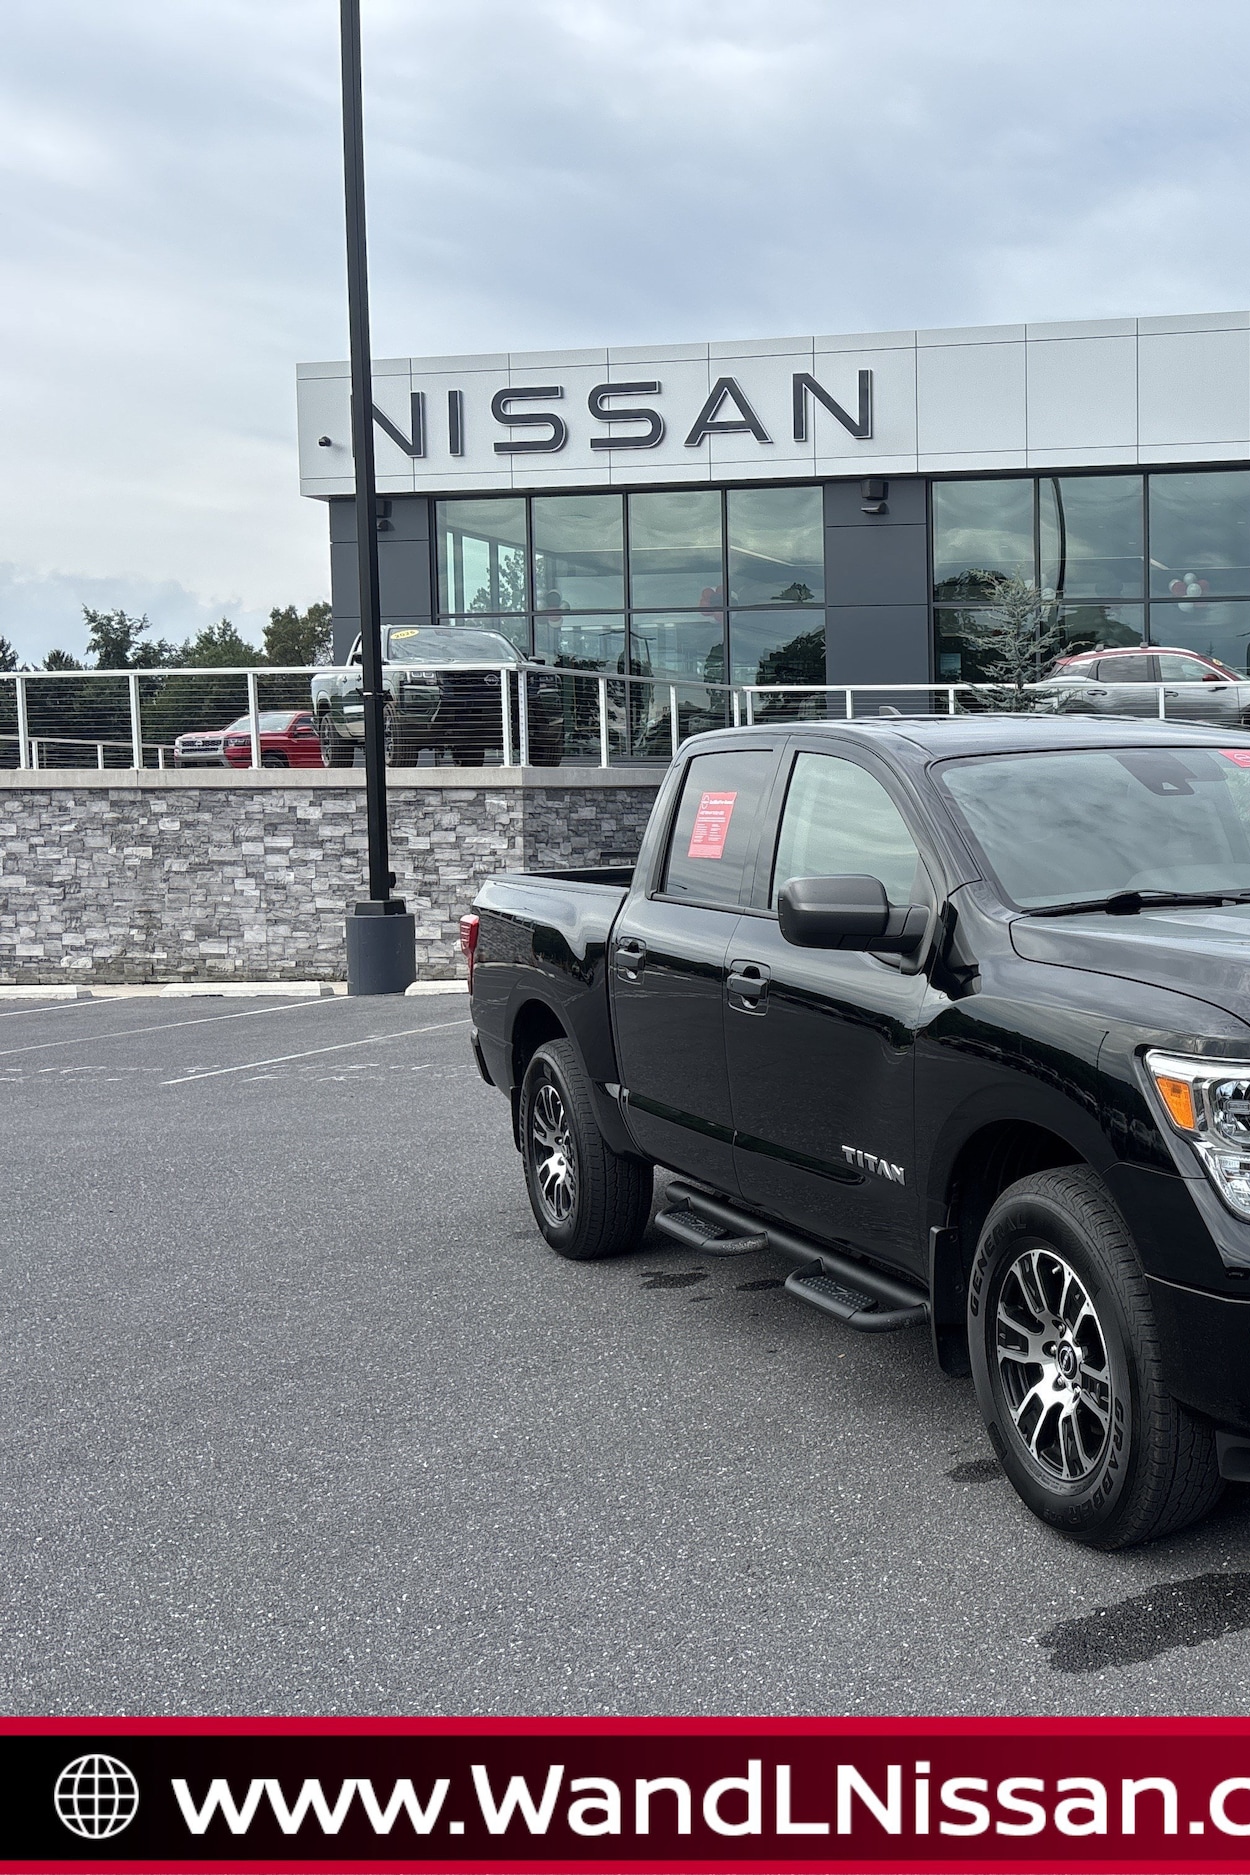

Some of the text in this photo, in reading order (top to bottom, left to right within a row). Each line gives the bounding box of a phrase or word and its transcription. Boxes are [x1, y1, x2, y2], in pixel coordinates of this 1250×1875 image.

[350, 368, 873, 459] NISSAN
[841, 1145, 905, 1186] TITAN
[970, 1212, 1028, 1317] GENERAL
[1067, 1396, 1125, 1525] GRABBER
